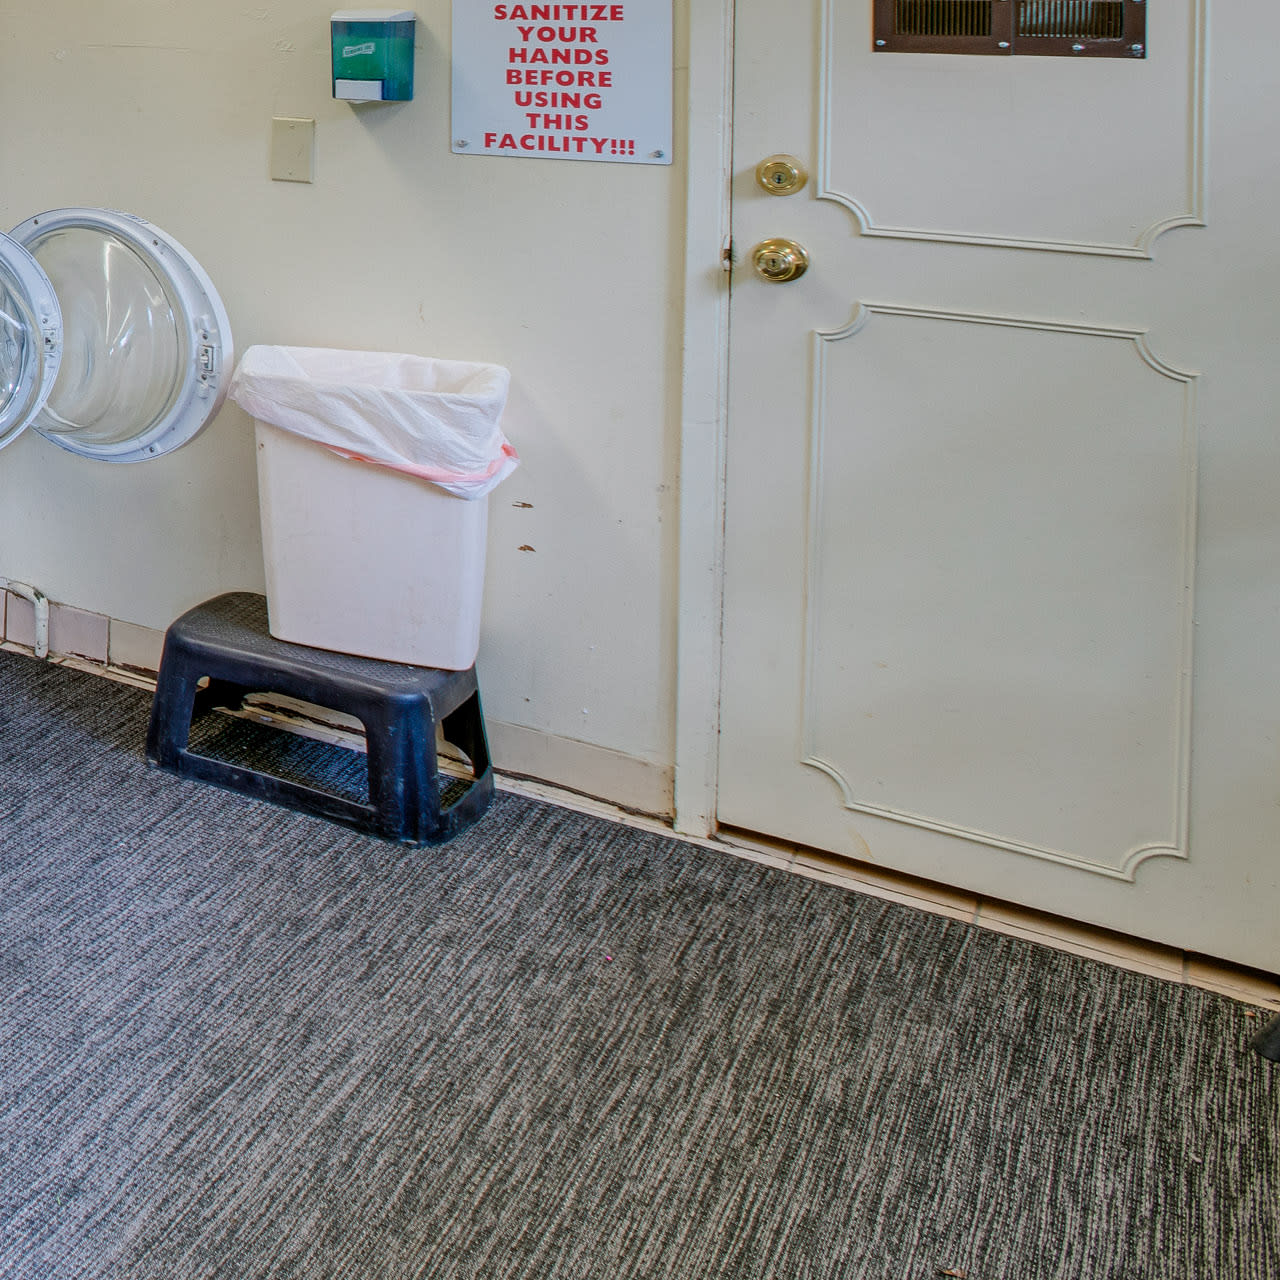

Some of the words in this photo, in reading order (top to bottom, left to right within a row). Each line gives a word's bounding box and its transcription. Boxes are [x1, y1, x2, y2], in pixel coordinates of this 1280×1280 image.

[494, 4, 624, 21] SANITIZE
[517, 27, 598, 43] YOUR
[509, 48, 609, 65] HANDS
[506, 70, 612, 88] BEFORE
[515, 92, 602, 109] USING
[526, 114, 588, 131] THIS
[484, 133, 635, 155] FACILITY!!!
